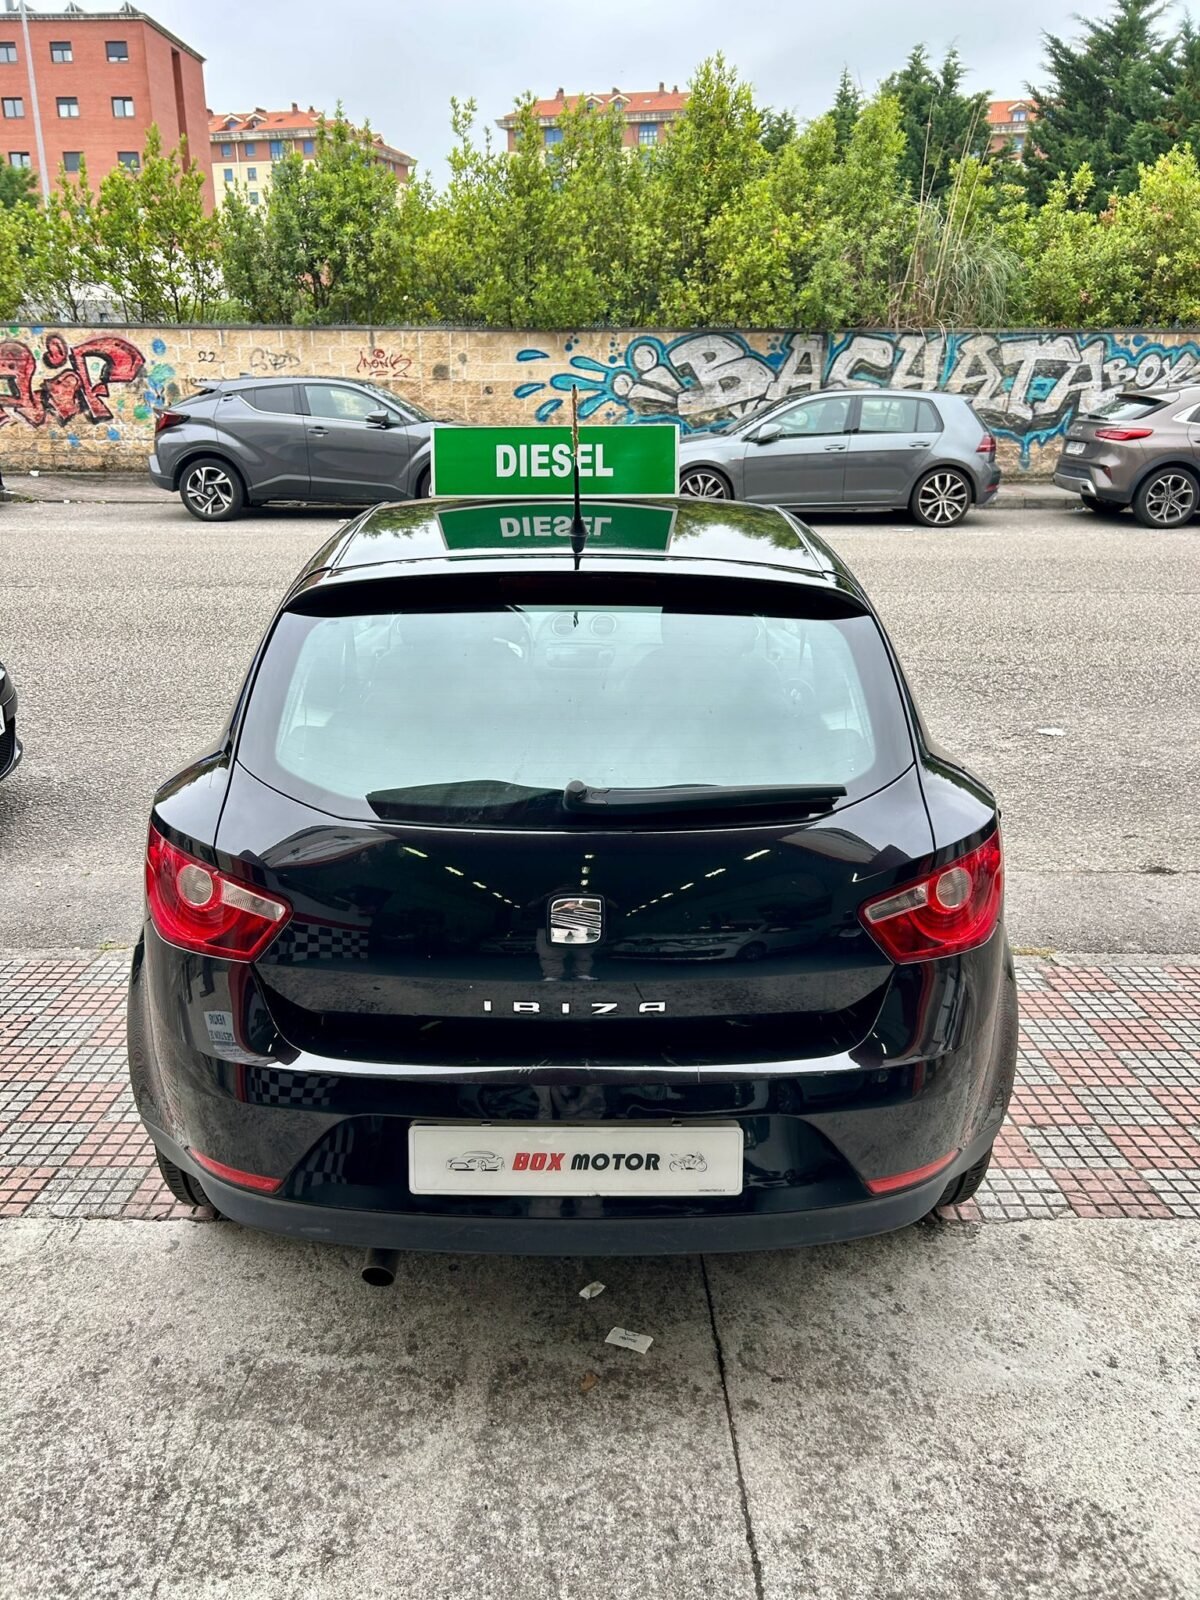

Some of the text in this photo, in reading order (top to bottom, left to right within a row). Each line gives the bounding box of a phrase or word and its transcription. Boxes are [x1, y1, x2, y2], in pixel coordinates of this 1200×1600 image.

[495, 444, 614, 478] DIESEL
[483, 1000, 666, 1014] IBIZA
[512, 1152, 661, 1171] BOX MOTOR
